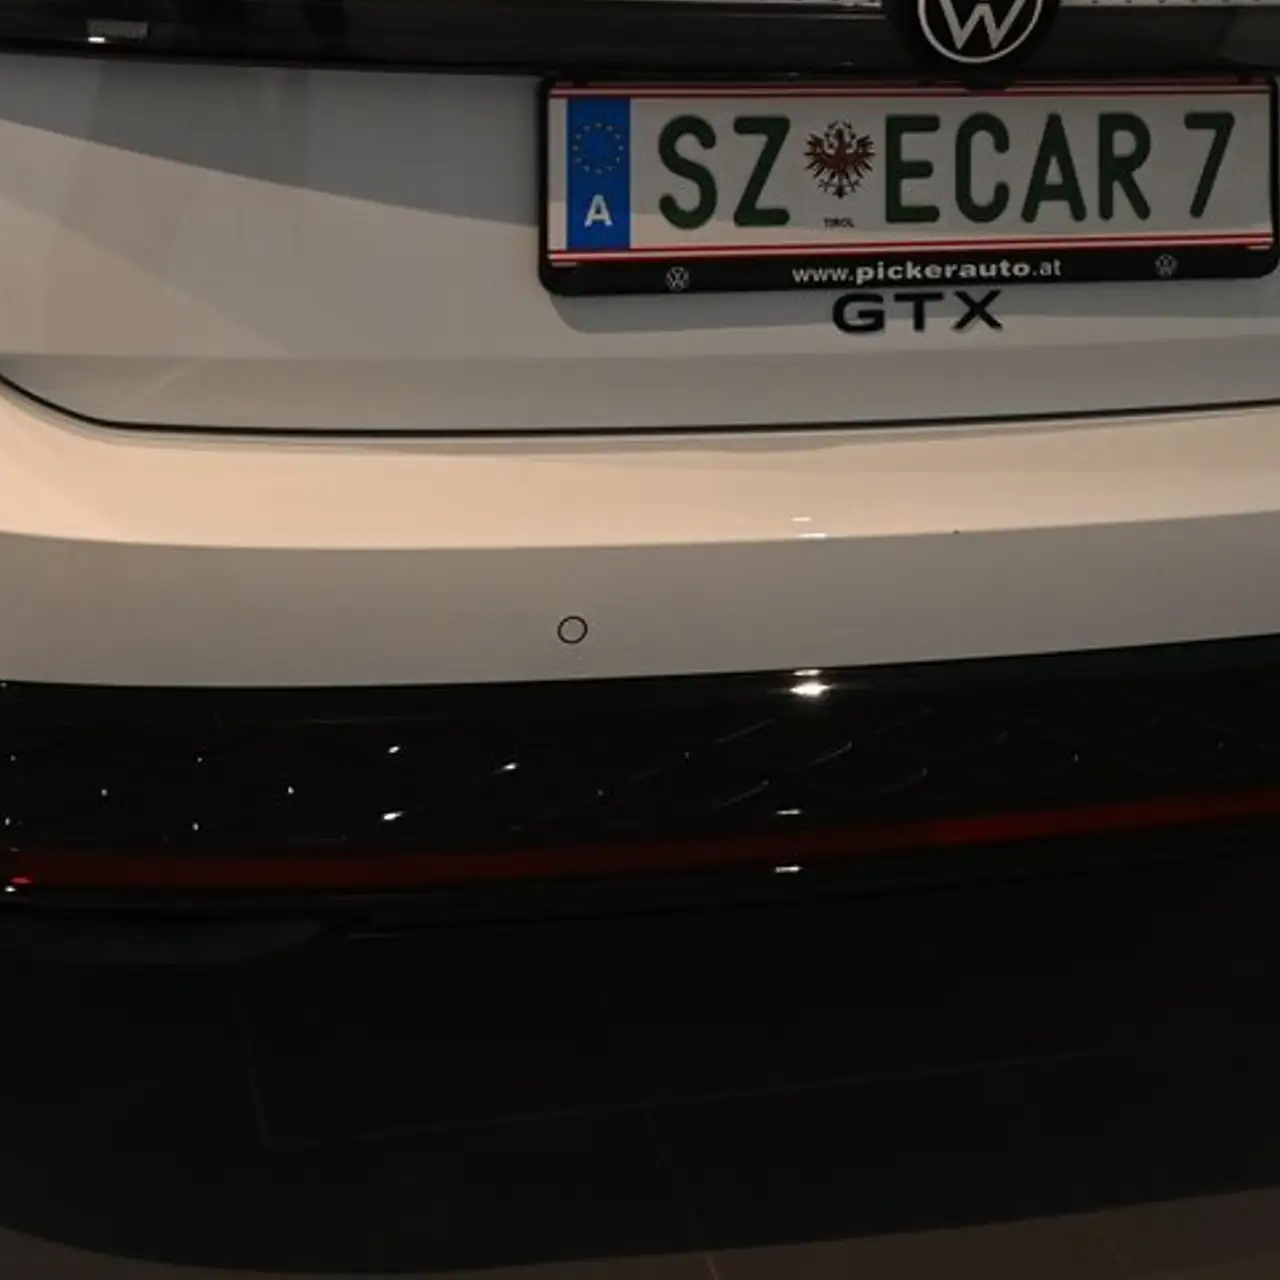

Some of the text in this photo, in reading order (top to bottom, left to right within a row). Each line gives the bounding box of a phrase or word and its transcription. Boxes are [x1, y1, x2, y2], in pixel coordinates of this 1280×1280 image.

[658, 110, 1236, 229] SZ ECAR 7
[583, 196, 613, 227] A
[792, 259, 1062, 286] www.pickerauto.at
[832, 290, 1004, 334] GTX
